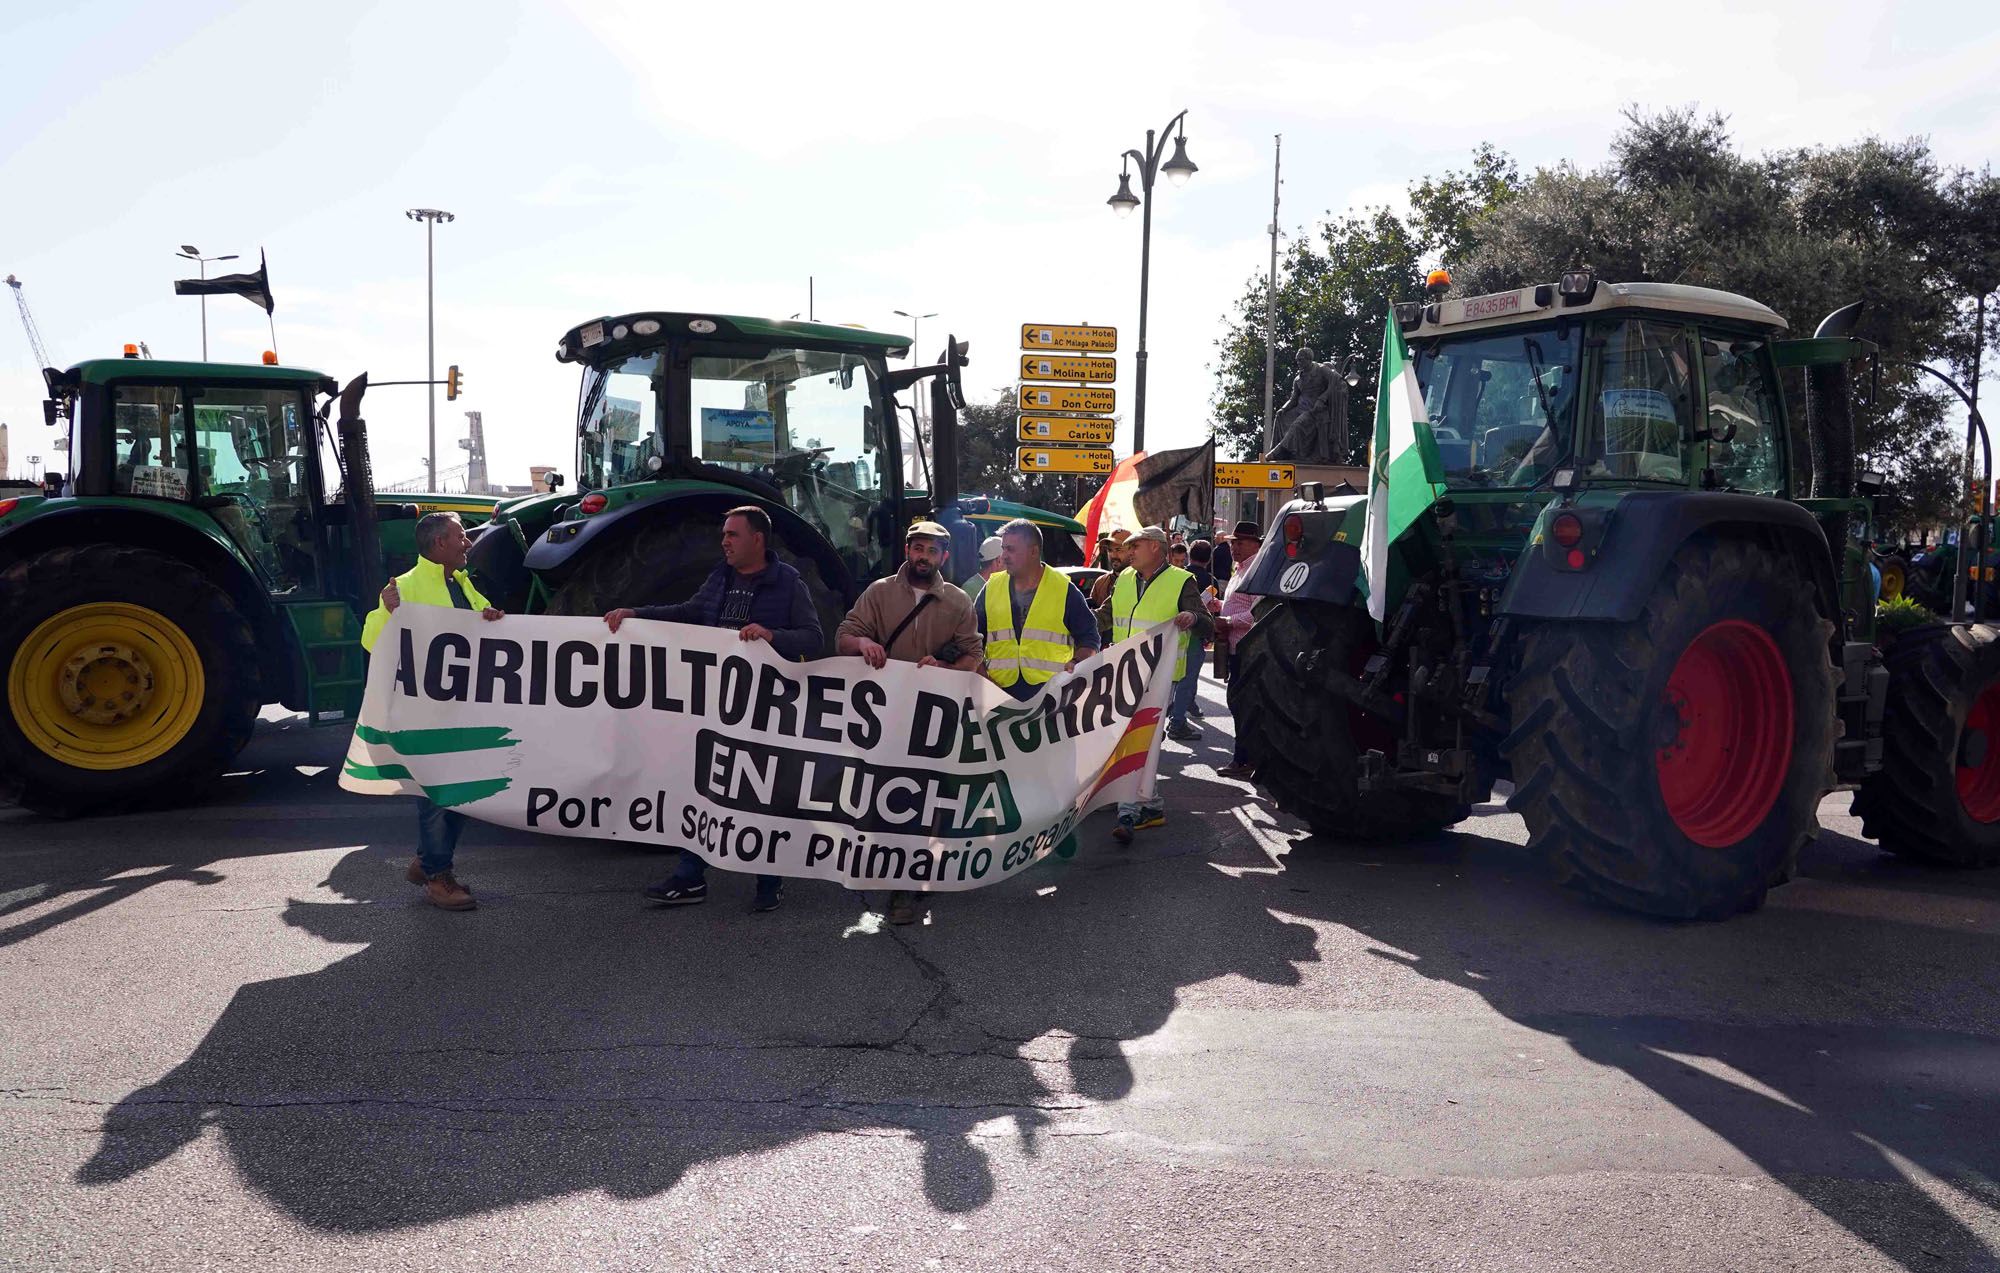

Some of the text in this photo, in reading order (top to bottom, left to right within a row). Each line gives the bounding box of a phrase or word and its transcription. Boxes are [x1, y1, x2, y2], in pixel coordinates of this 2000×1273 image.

[1091, 329, 1115, 338] Hotel
[1054, 338, 1064, 346] AC
[1091, 340, 1114, 349] Palacio
[1091, 361, 1113, 369] Hotel
[1053, 369, 1113, 379] Molina Lario
[1090, 391, 1113, 399] Hotel
[1062, 400, 1113, 409] Don Curro
[1089, 422, 1112, 430] Hotel
[1068, 430, 1112, 440] Carlos V
[1088, 452, 1111, 460] Hotel
[1093, 461, 1110, 470] Sur
[1215, 476, 1240, 485] toria
[1284, 564, 1306, 590] 40
[394, 627, 887, 751] AGRICULTORES
[907, 690, 988, 764] DE
[708, 741, 1007, 829] EN LUCHA
[526, 787, 612, 829] Por
[628, 790, 666, 834] el
[681, 804, 791, 863] sector
[805, 834, 993, 882] primario
